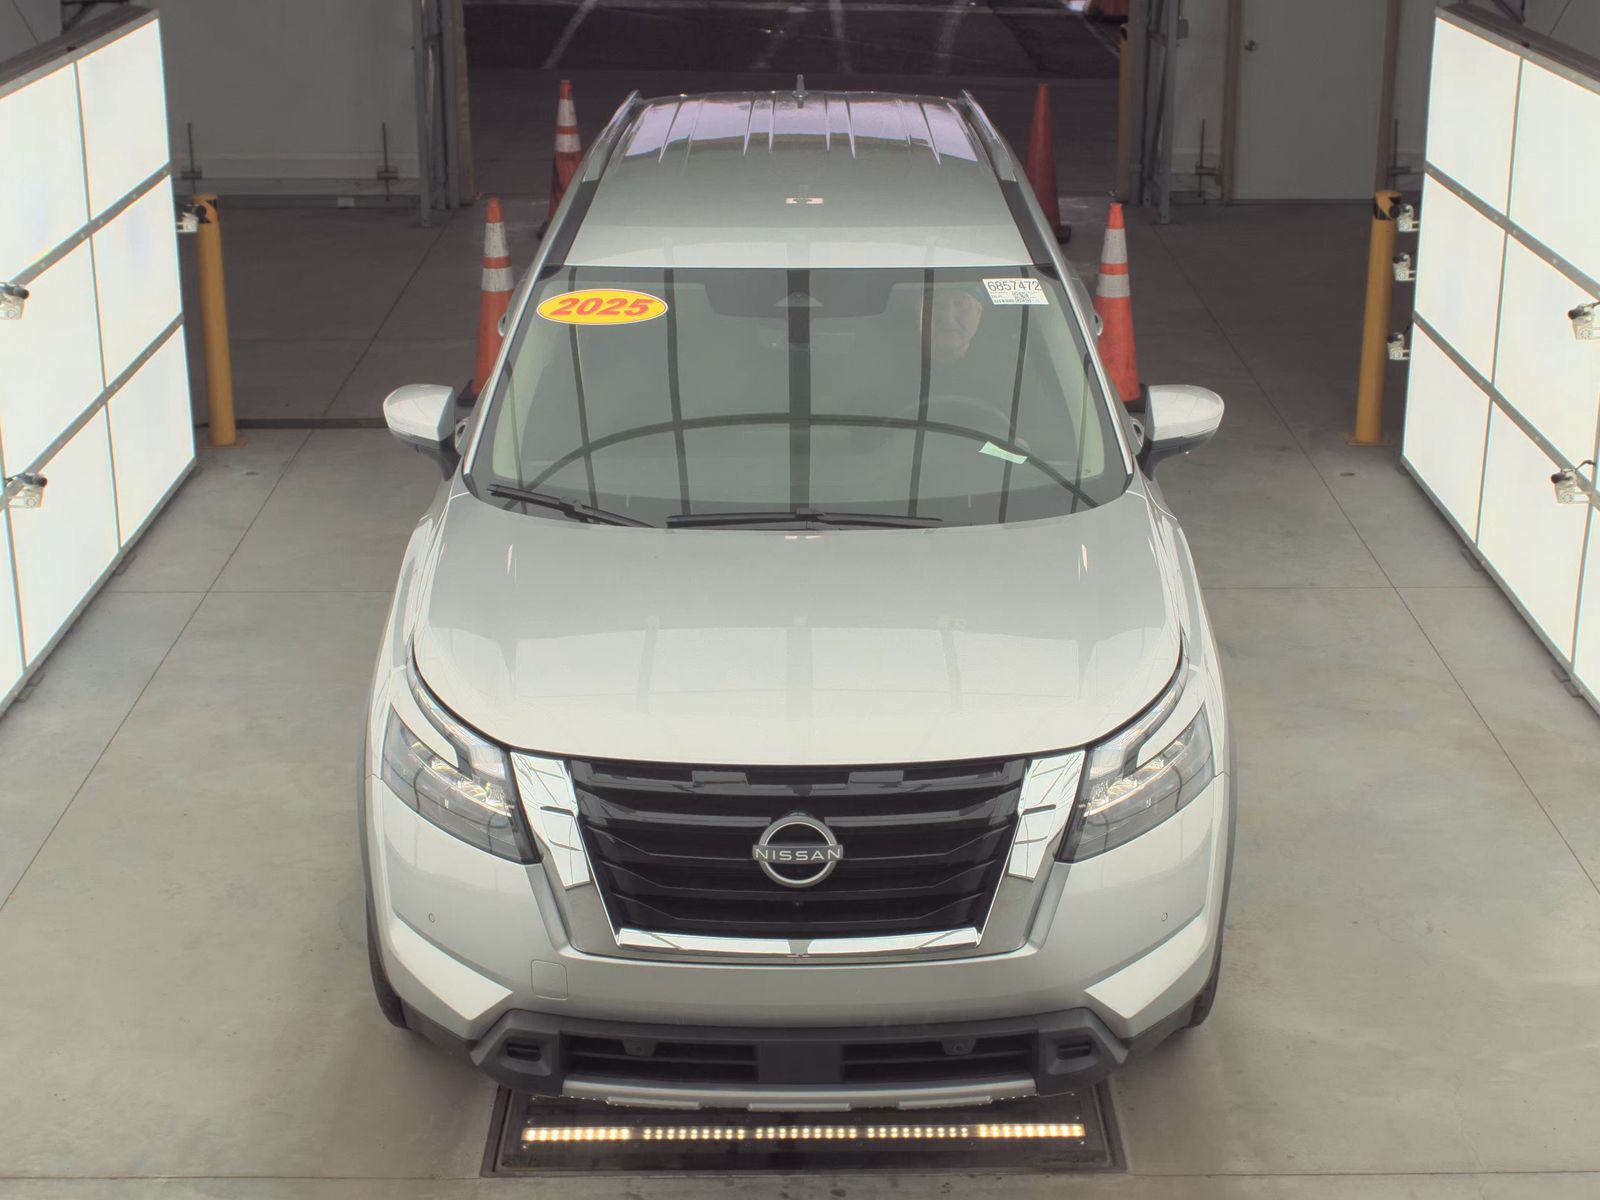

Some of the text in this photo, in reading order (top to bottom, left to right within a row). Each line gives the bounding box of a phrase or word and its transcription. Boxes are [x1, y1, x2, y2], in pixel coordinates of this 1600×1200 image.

[987, 280, 1042, 291] 6857472
[549, 298, 654, 317] 2025
[755, 848, 841, 861] NISSAN
